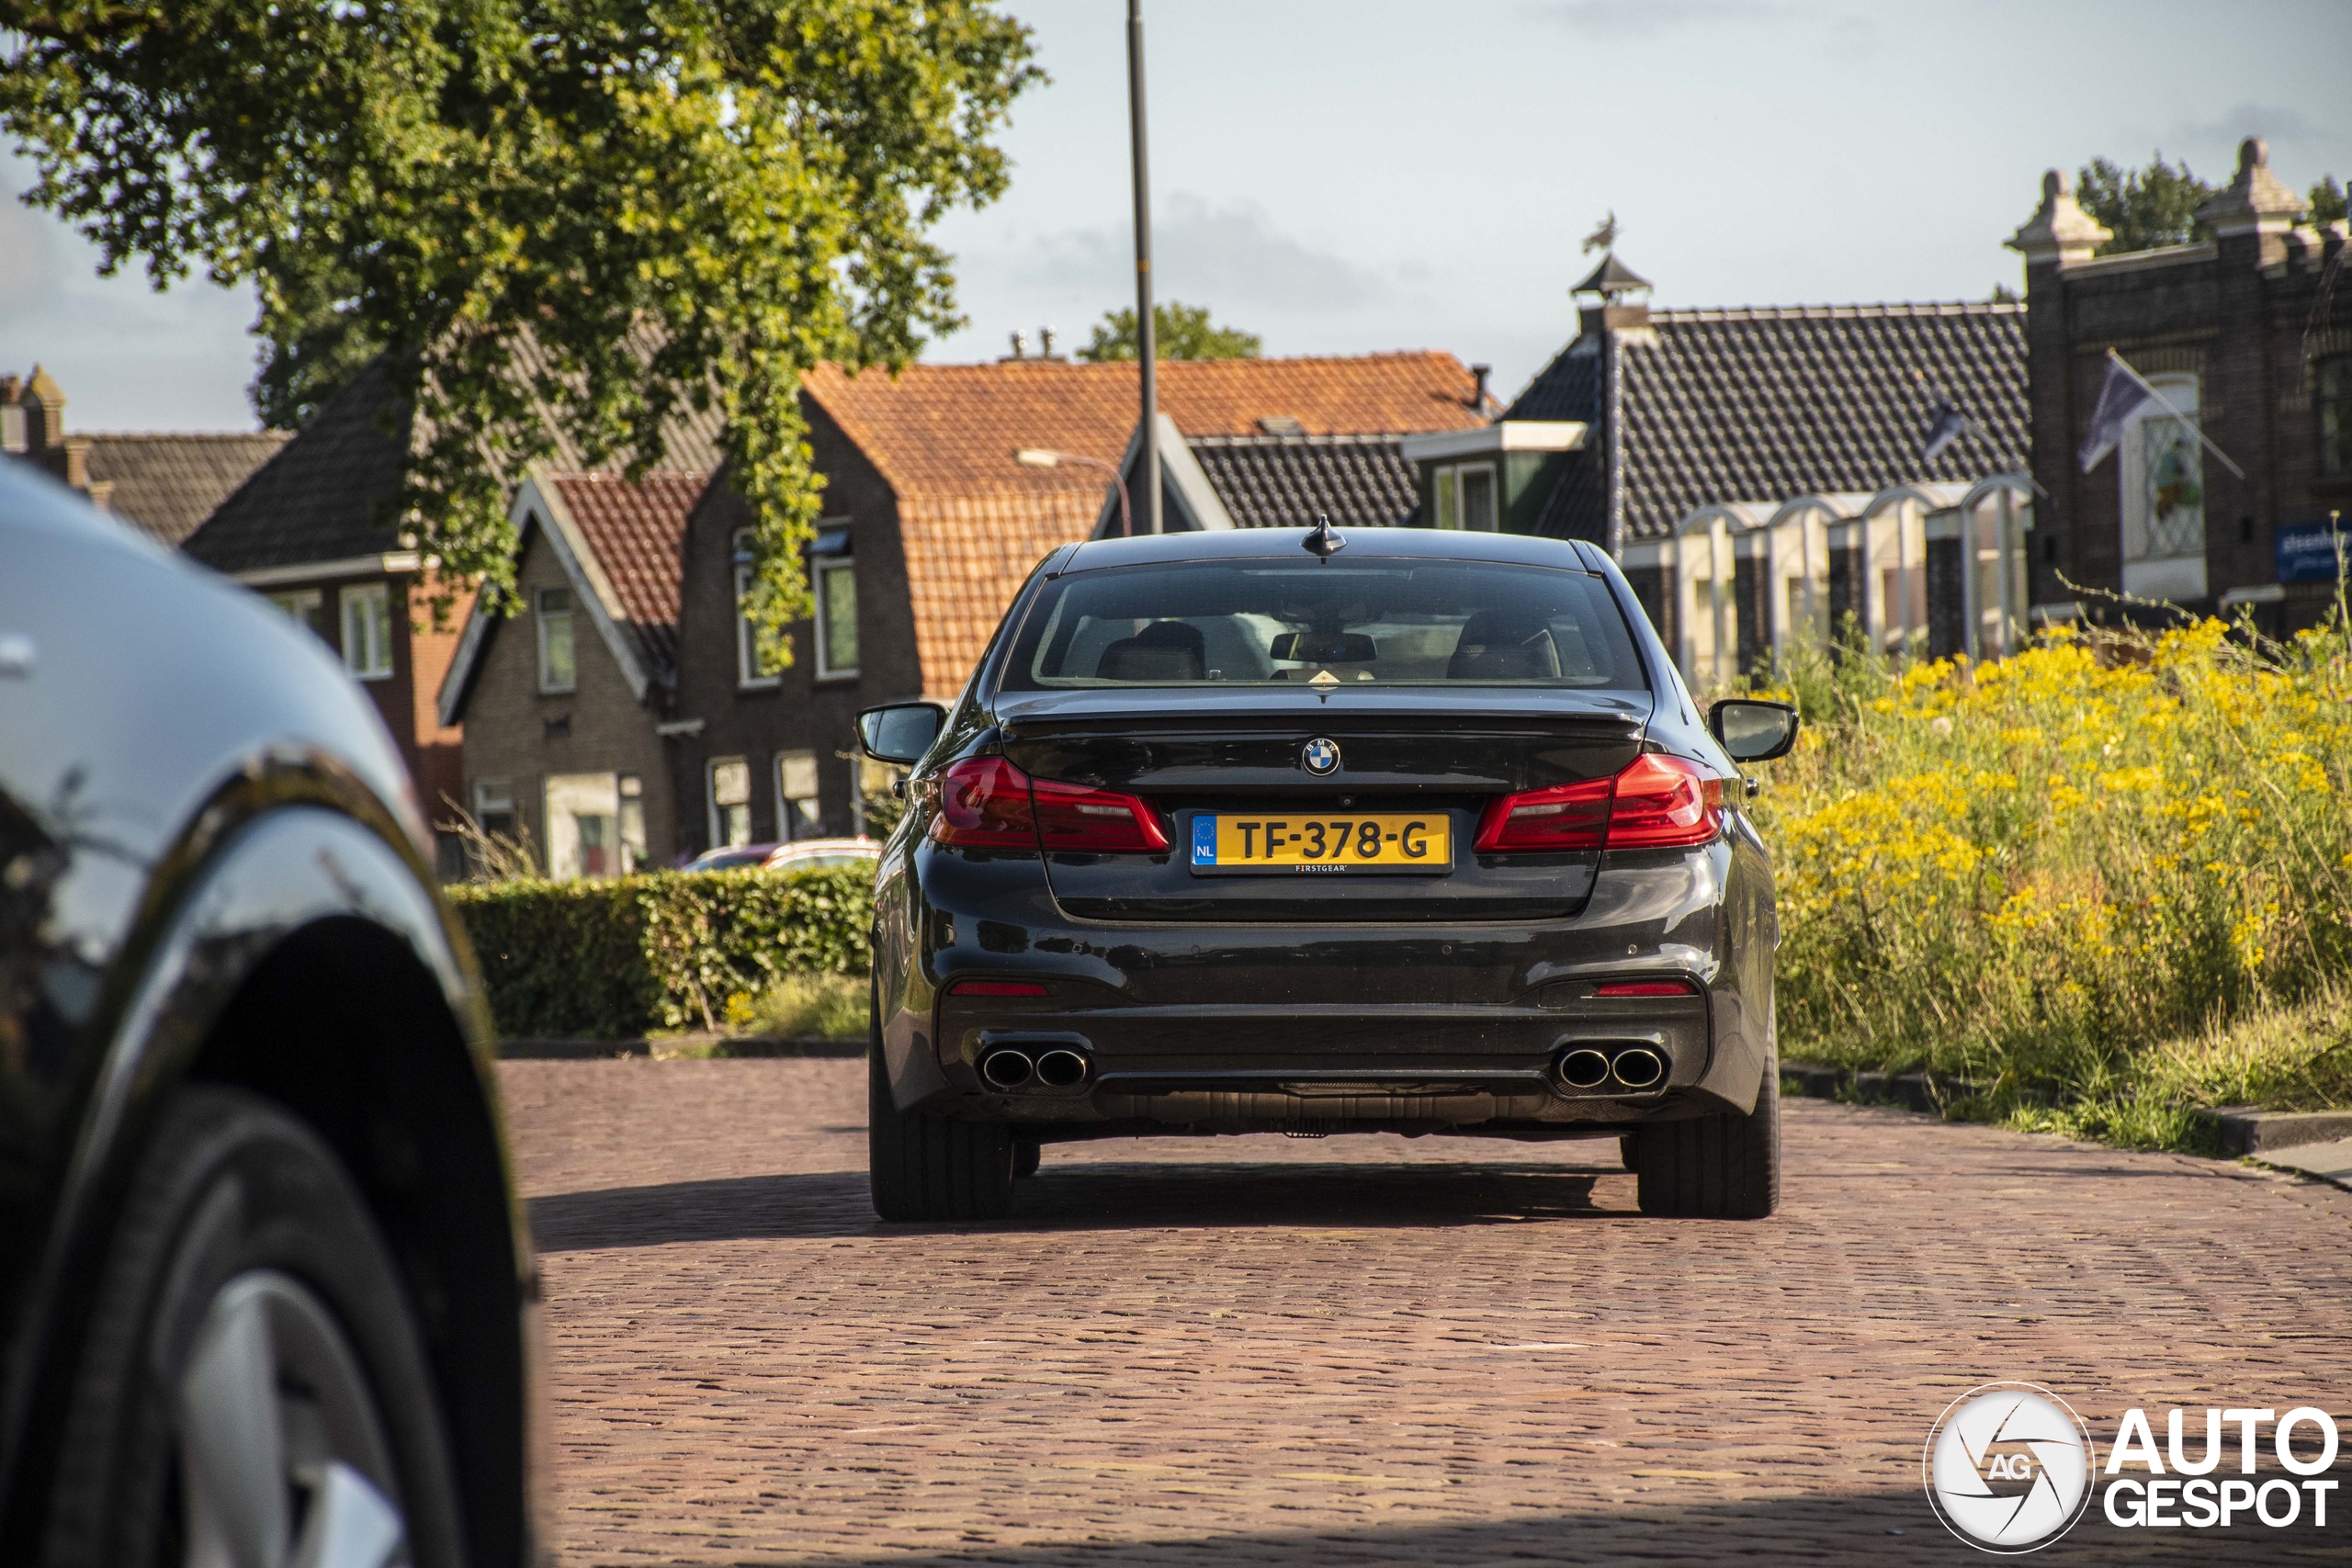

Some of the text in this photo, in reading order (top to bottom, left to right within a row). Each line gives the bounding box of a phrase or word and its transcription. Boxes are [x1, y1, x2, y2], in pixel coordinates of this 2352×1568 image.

[1306, 739, 1337, 751] BMW
[1237, 821, 1428, 858] TF-378-G
[1196, 845, 1214, 857] NL
